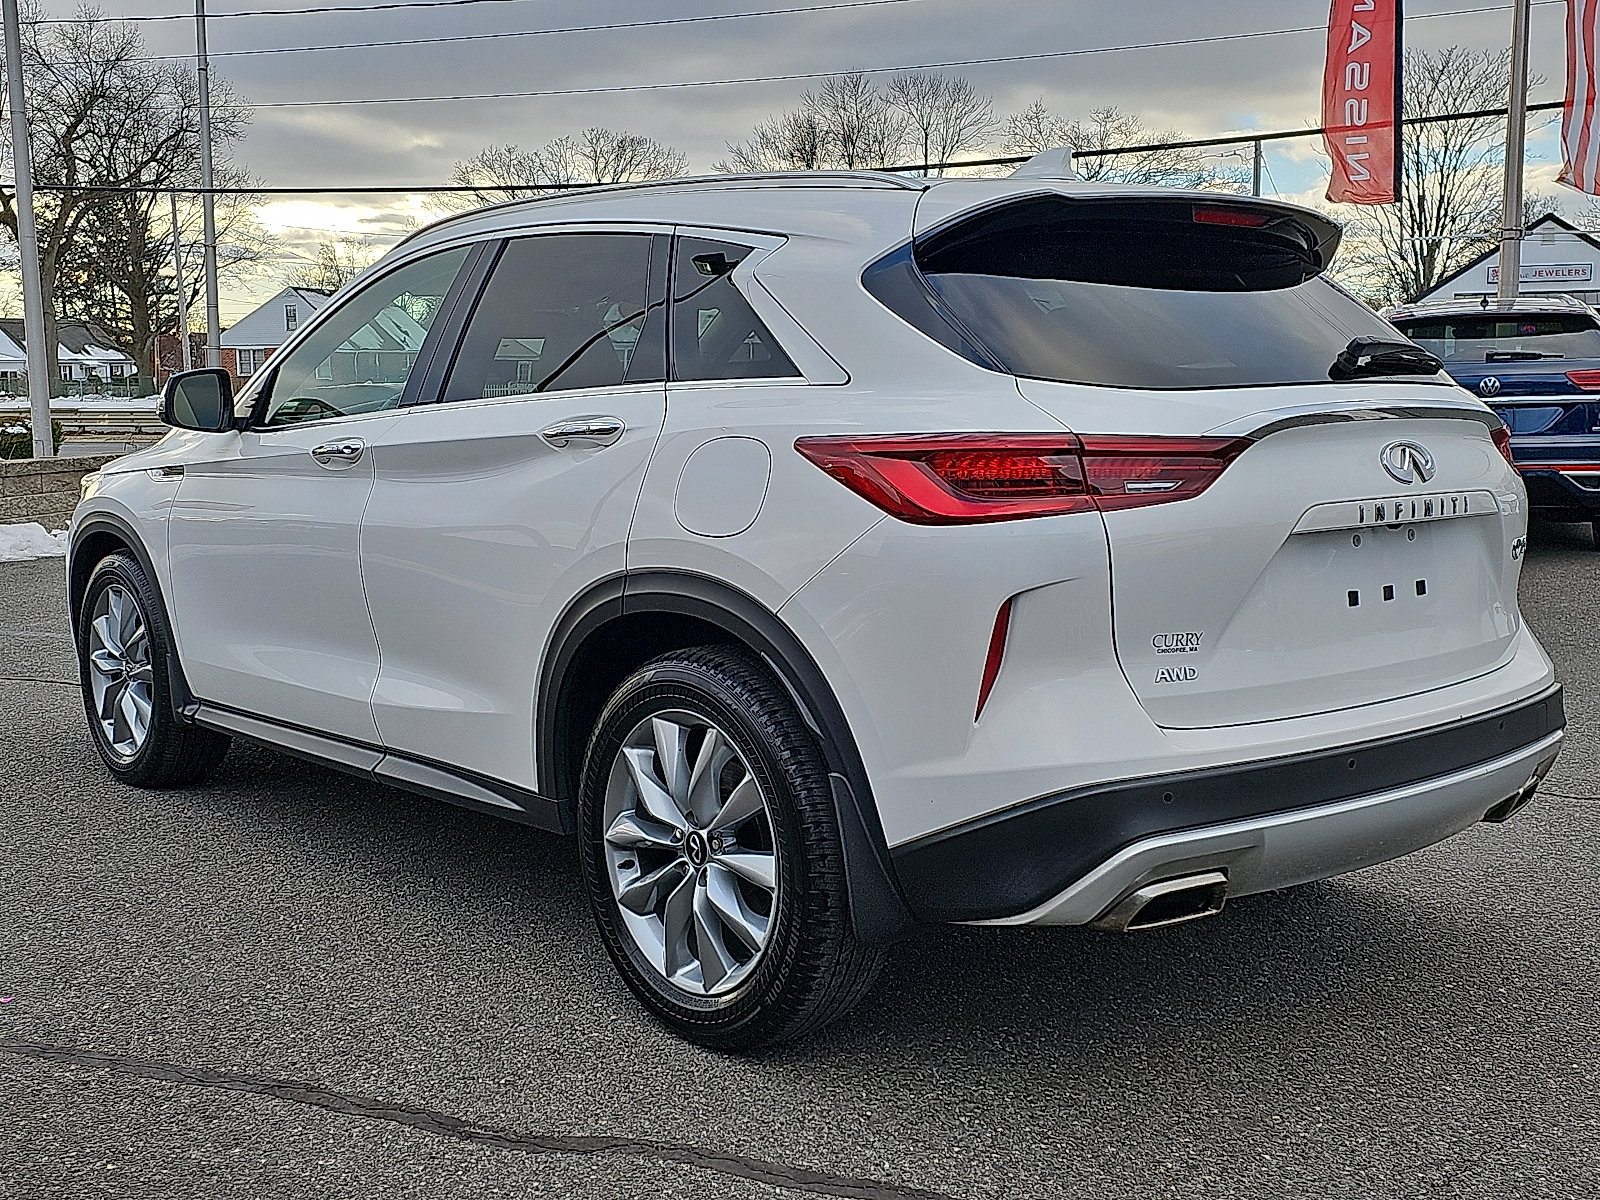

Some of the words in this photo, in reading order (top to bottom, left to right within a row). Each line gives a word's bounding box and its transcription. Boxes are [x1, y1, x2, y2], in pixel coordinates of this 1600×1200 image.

[1532, 268, 1587, 278] JEWELERS
[1358, 495, 1470, 523] INFINITI
[1152, 631, 1204, 648] CURRY
[1154, 665, 1199, 684] AWD
